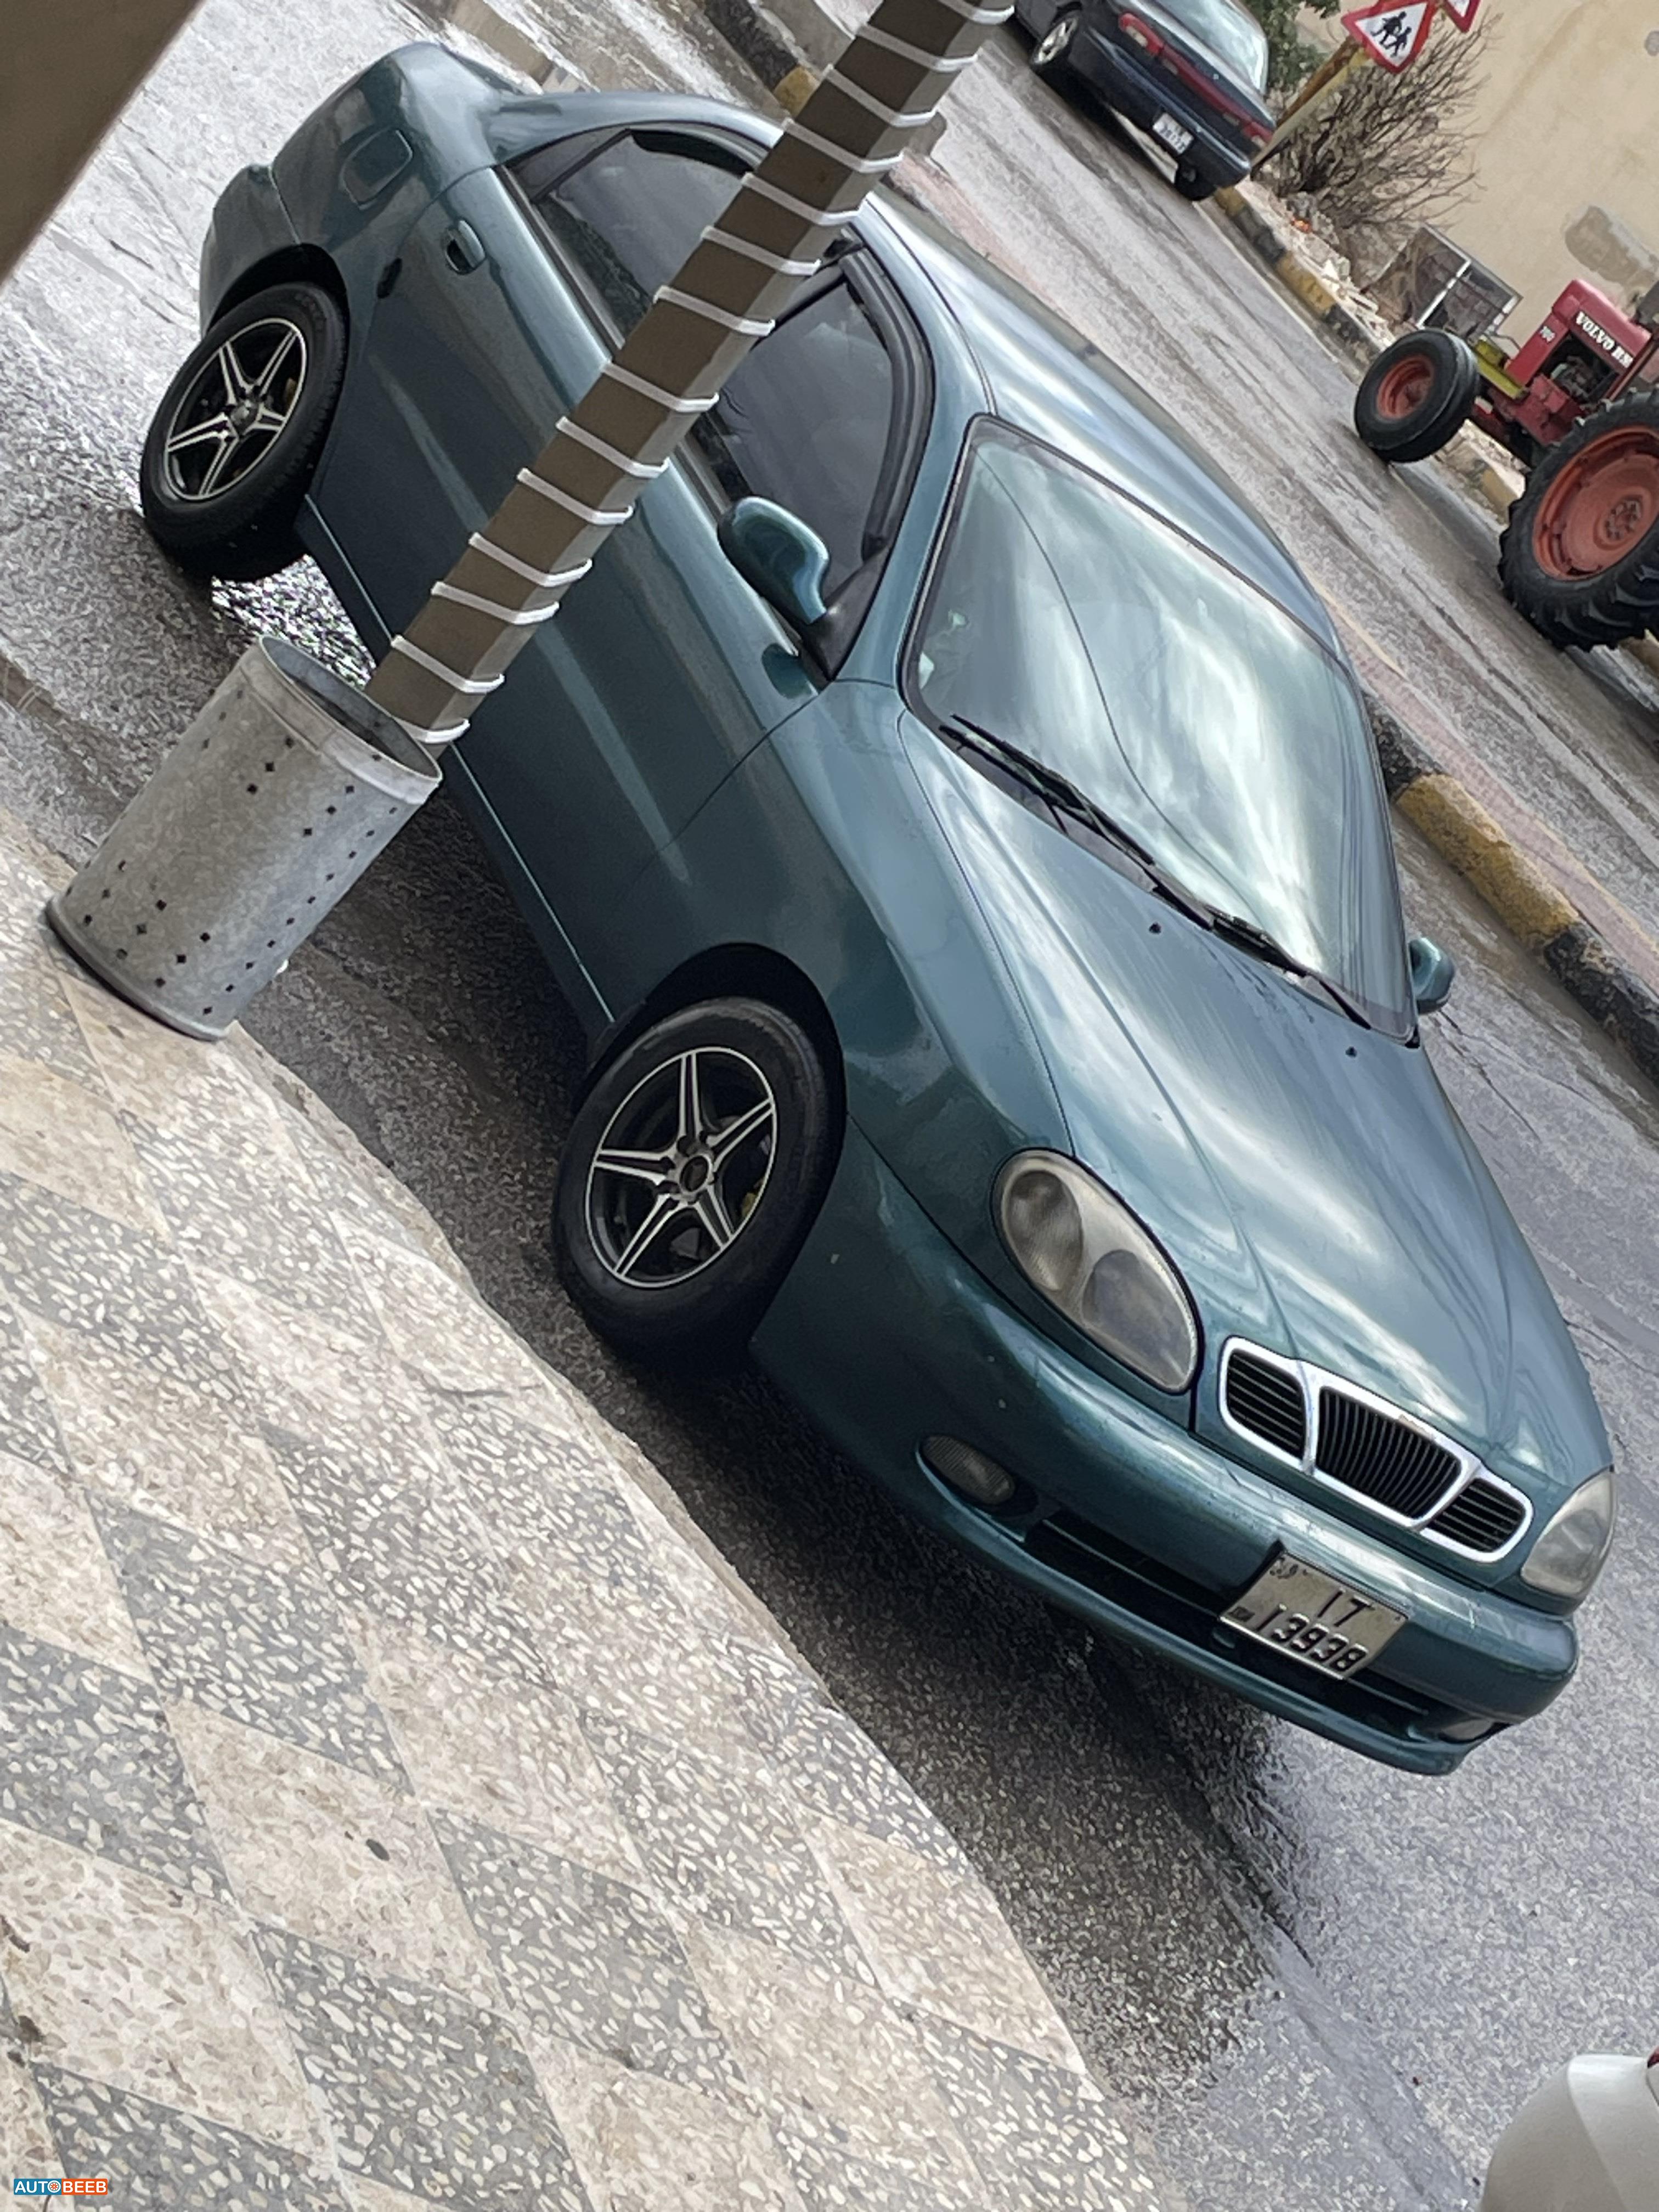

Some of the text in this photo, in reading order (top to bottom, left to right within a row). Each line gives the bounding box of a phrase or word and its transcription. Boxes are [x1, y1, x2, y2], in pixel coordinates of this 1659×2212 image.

[1576, 311, 1616, 351] VOLVO
[1316, 1588, 1376, 1628] 17
[1255, 1602, 1369, 1672] 13938
